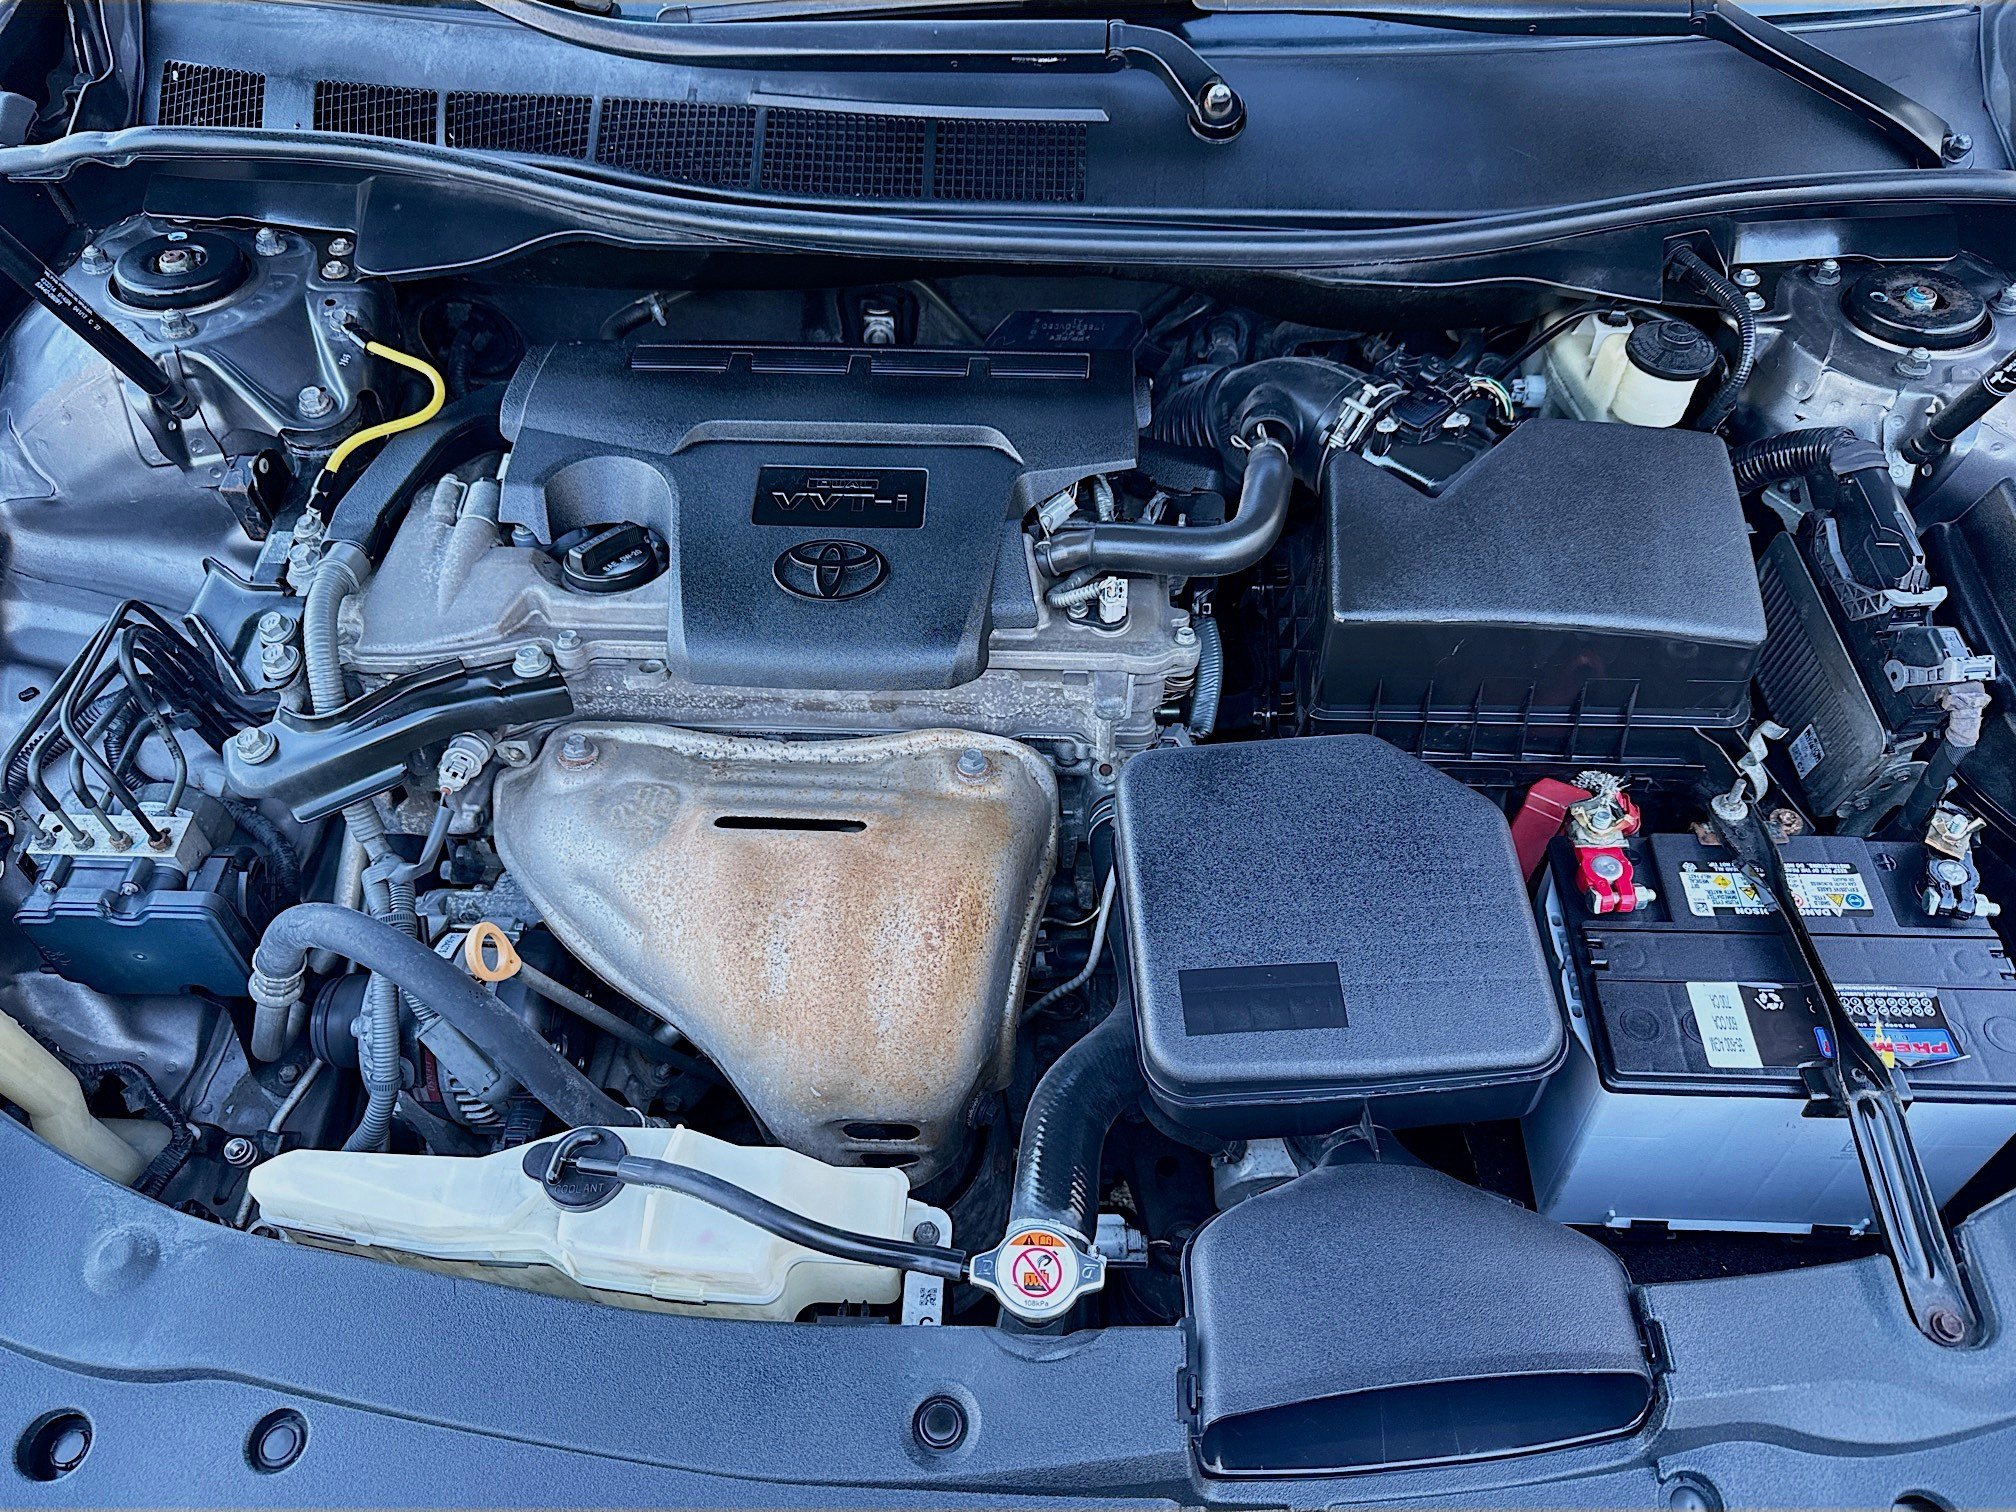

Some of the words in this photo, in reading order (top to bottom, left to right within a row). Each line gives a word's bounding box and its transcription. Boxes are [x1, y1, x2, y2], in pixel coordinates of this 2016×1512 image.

[771, 491, 908, 512] VVT-i
[602, 560, 620, 573] SAE
[425, 1061, 436, 1092] DENSO
[554, 1183, 605, 1195] COOLANT
[1024, 1299, 1049, 1308] 108kPa
